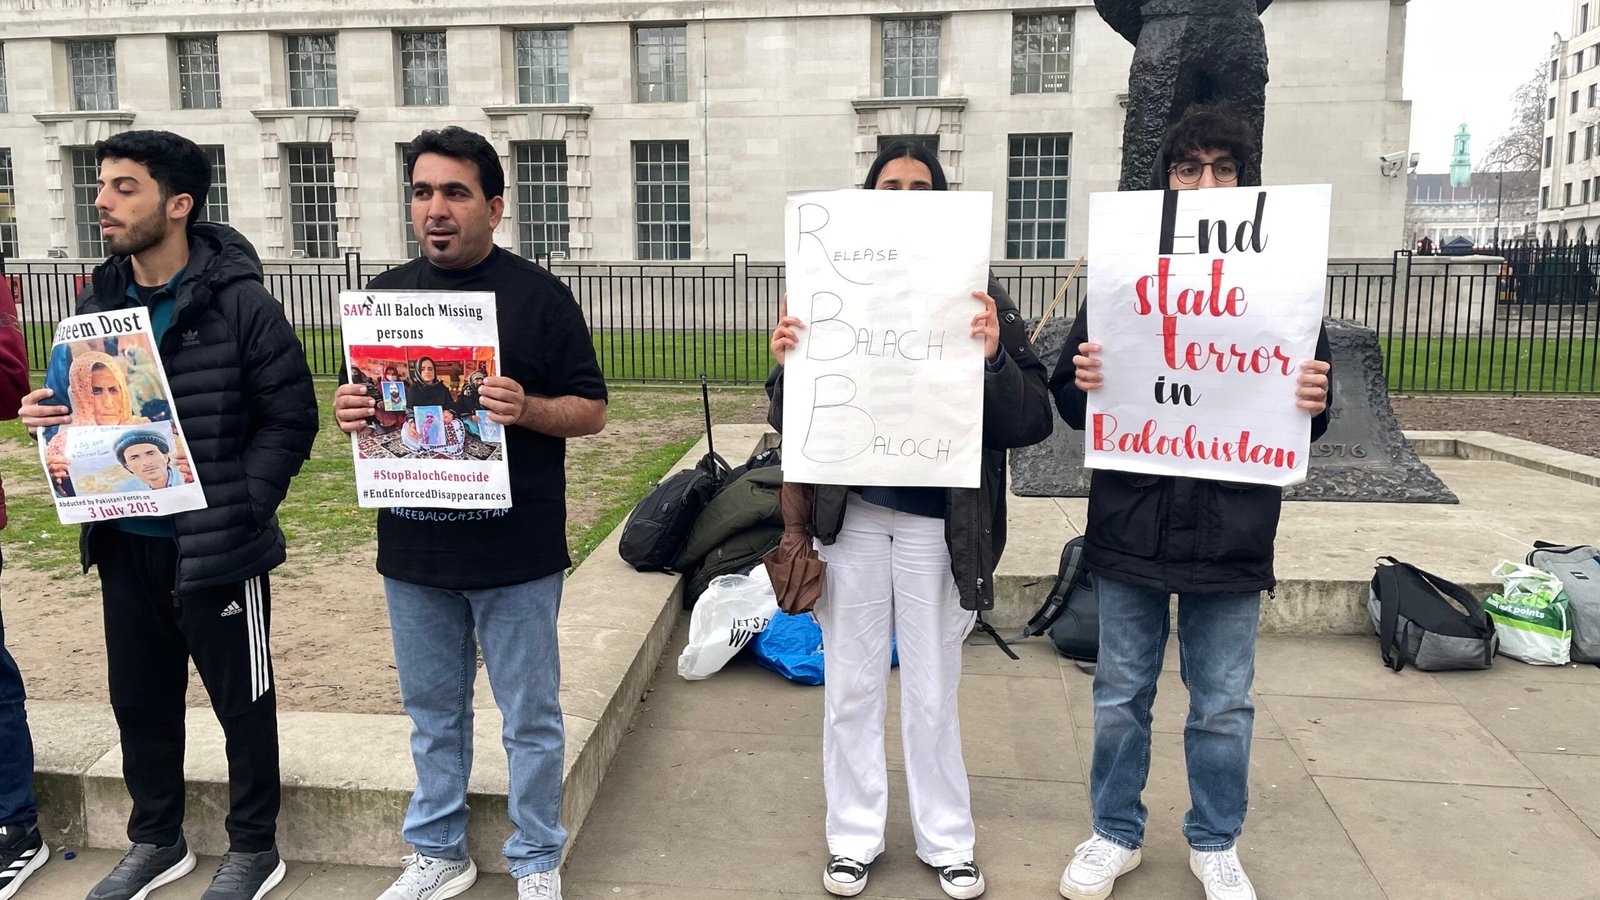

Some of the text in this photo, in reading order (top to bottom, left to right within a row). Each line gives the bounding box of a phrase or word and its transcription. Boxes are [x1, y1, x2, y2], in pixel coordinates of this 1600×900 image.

[1159, 188, 1268, 256] End
[1133, 257, 1248, 317] state
[343, 303, 483, 321] SAVE All Baloch Missing
[97, 312, 142, 334] Dost
[376, 328, 424, 342] persons
[1156, 316, 1295, 377] terror
[1154, 375, 1202, 406] in
[1092, 413, 1301, 469] Balochistan
[373, 469, 490, 482] #StopBalochGenocide
[95, 495, 123, 505] Pakistani
[363, 488, 507, 502] #EndEnforcedDisappearances
[88, 501, 159, 519] 3 July 2015
[1513, 606, 1545, 618] points
[733, 617, 760, 629] LET'S
